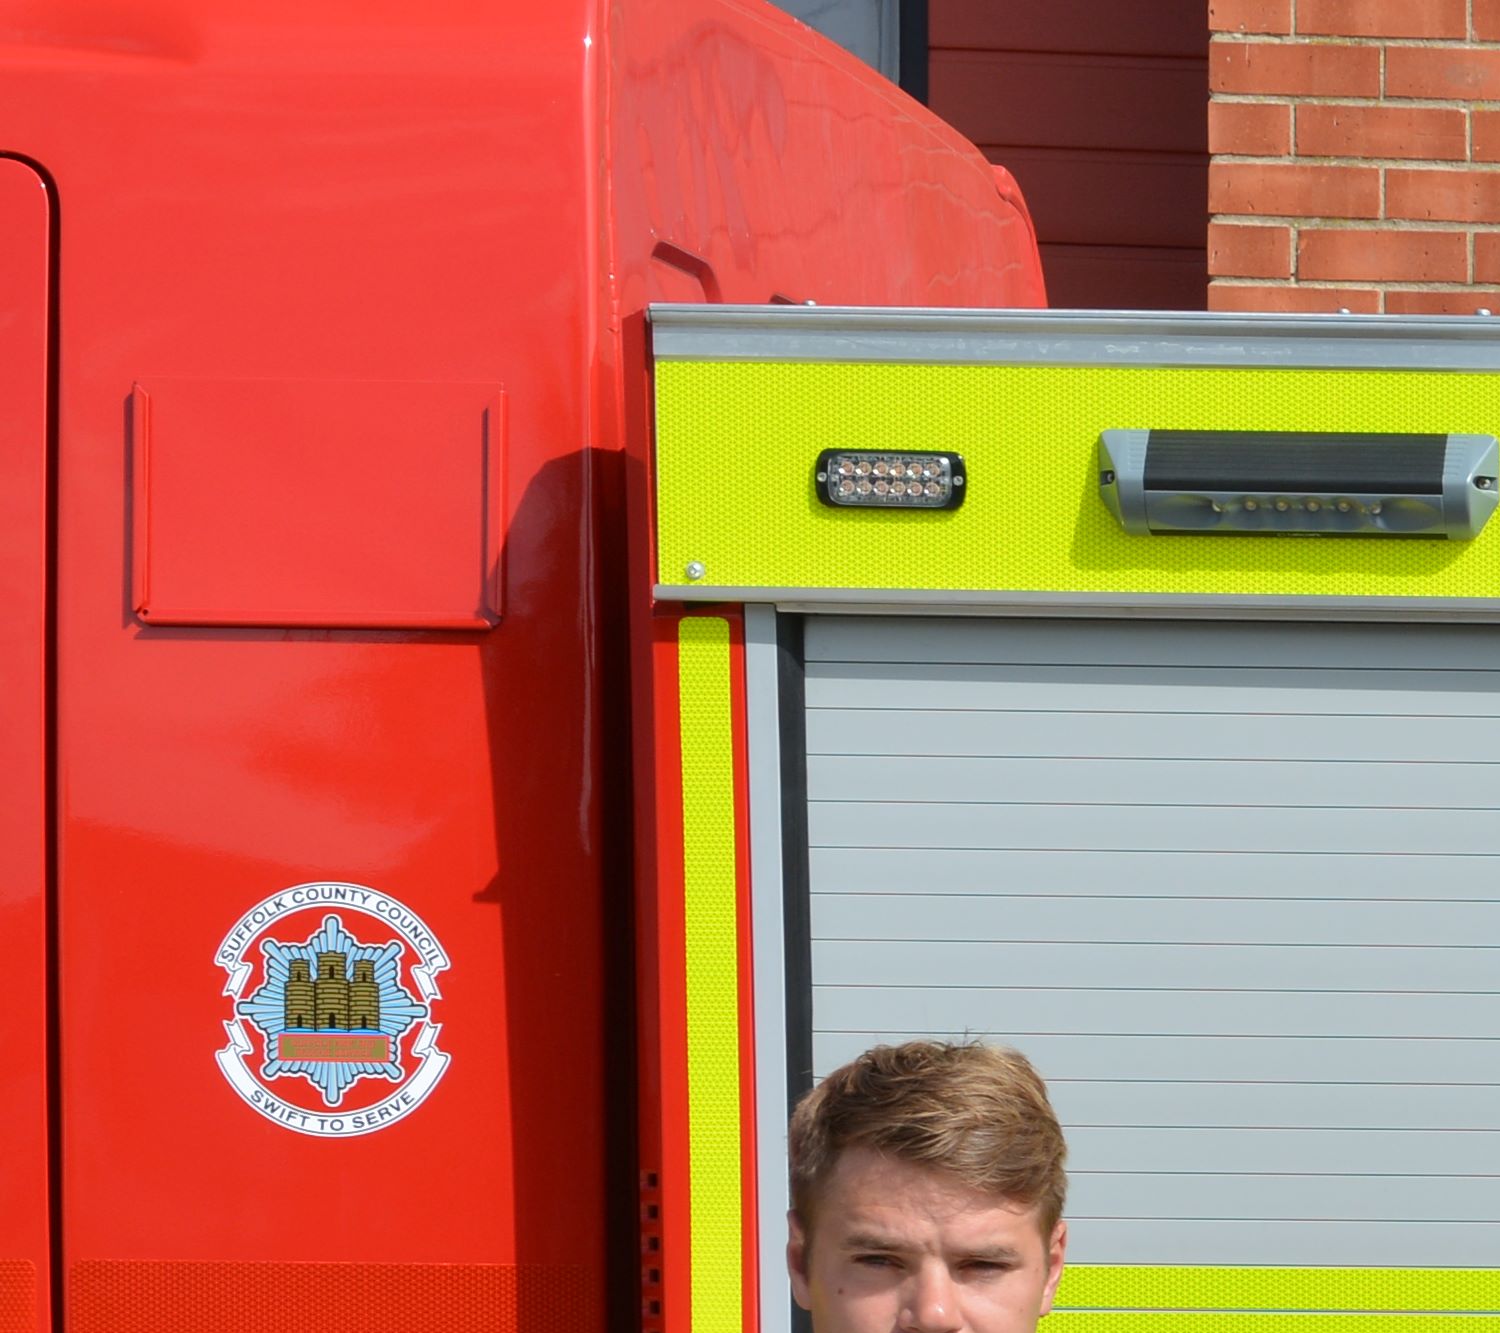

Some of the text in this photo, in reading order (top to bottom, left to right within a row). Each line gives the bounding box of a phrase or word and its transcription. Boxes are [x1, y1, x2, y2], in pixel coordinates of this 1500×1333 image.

[221, 886, 440, 964] SUFFOLK COUNTY COUNCIL
[250, 1089, 416, 1132] SWIFT TO SERVE
